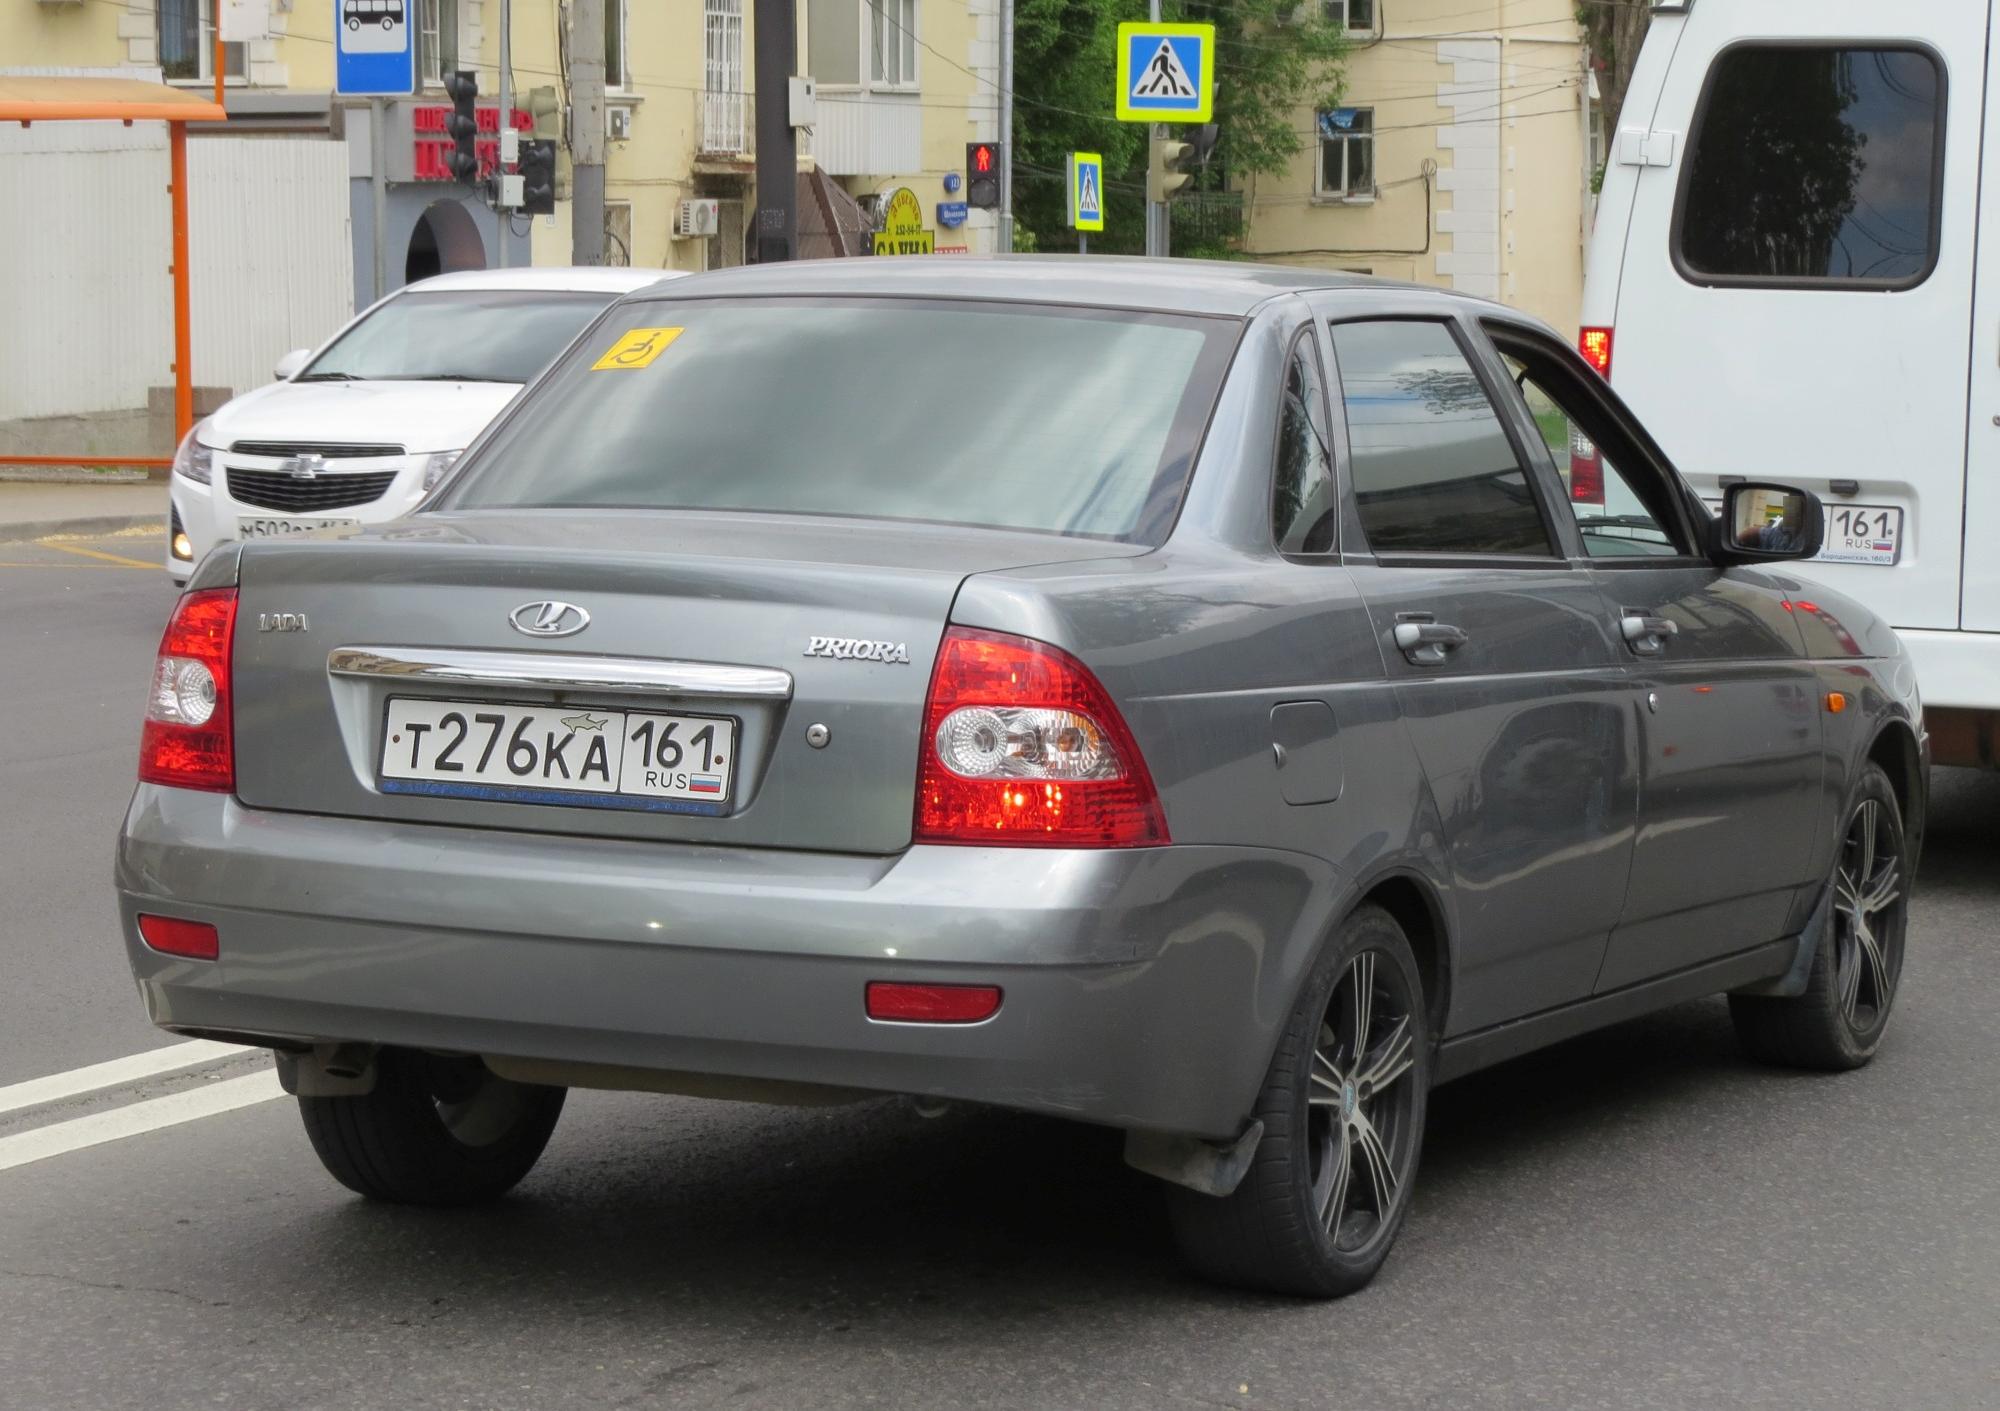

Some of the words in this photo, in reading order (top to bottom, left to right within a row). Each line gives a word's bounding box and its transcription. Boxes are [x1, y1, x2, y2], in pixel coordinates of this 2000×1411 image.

[1836, 510, 1888, 538] 161
[1845, 538, 1872, 549] RUS
[259, 613, 308, 632] LADA
[803, 636, 911, 664] PRIORA
[630, 719, 716, 773] 161
[644, 770, 688, 790] RUS
